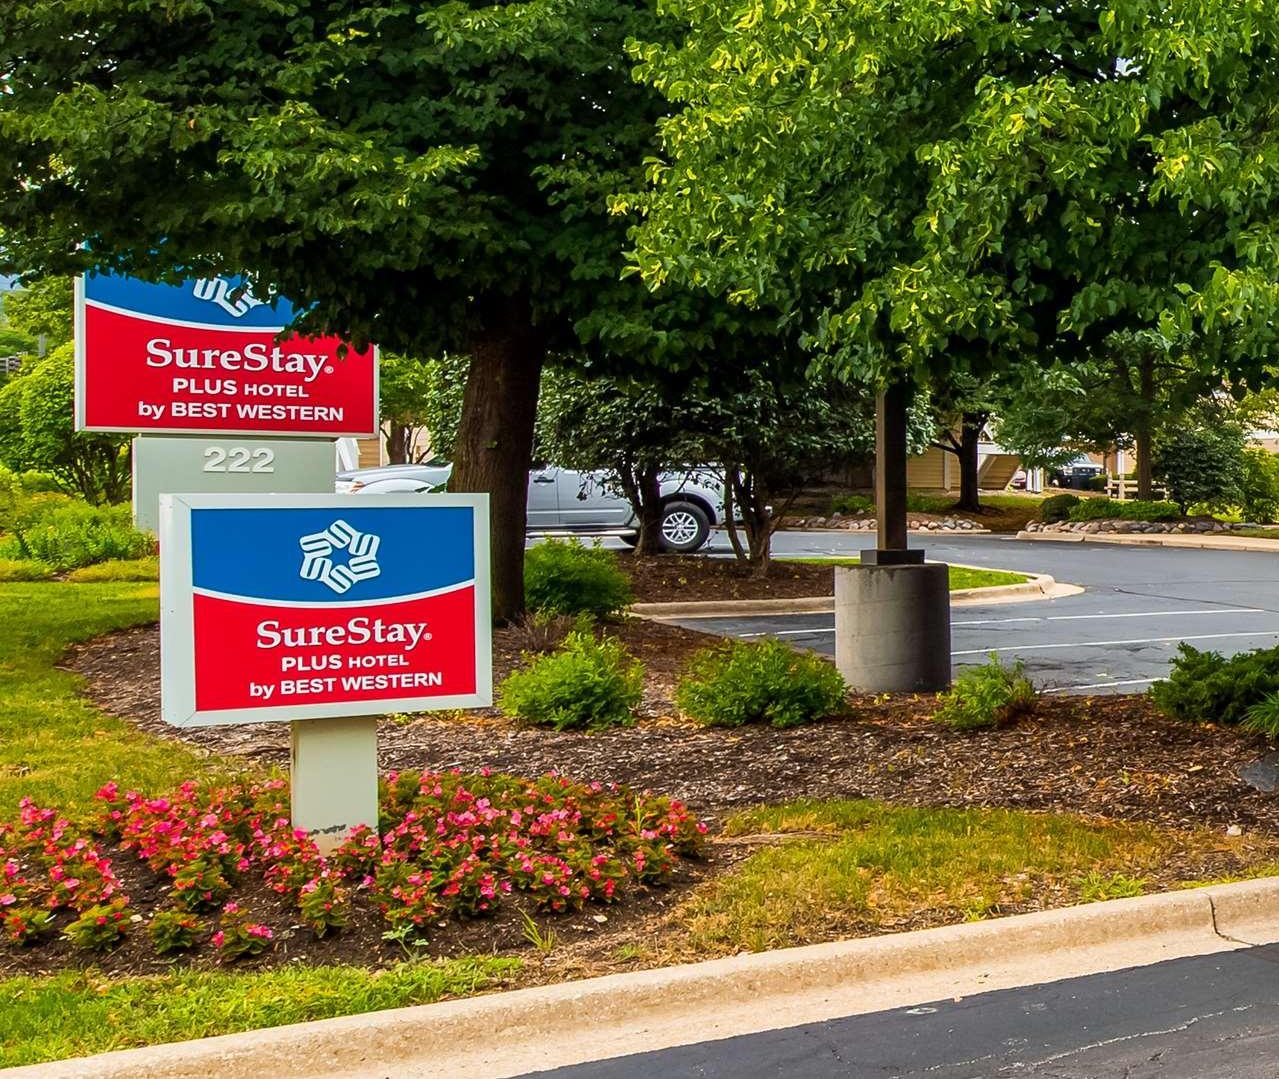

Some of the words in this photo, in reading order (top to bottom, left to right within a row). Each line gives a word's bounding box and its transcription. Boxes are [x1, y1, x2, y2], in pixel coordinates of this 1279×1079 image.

[172, 377, 237, 395] PLUS
[244, 383, 309, 397] HOTEL
[138, 401, 165, 420] by
[171, 402, 231, 418] BEST
[236, 404, 344, 421] WESTERN
[203, 446, 275, 473] 222
[281, 654, 342, 672] PLUS
[348, 654, 409, 668] HOTEL
[250, 682, 275, 699] by
[280, 677, 337, 695] BEST
[341, 672, 442, 691] WESTERN
